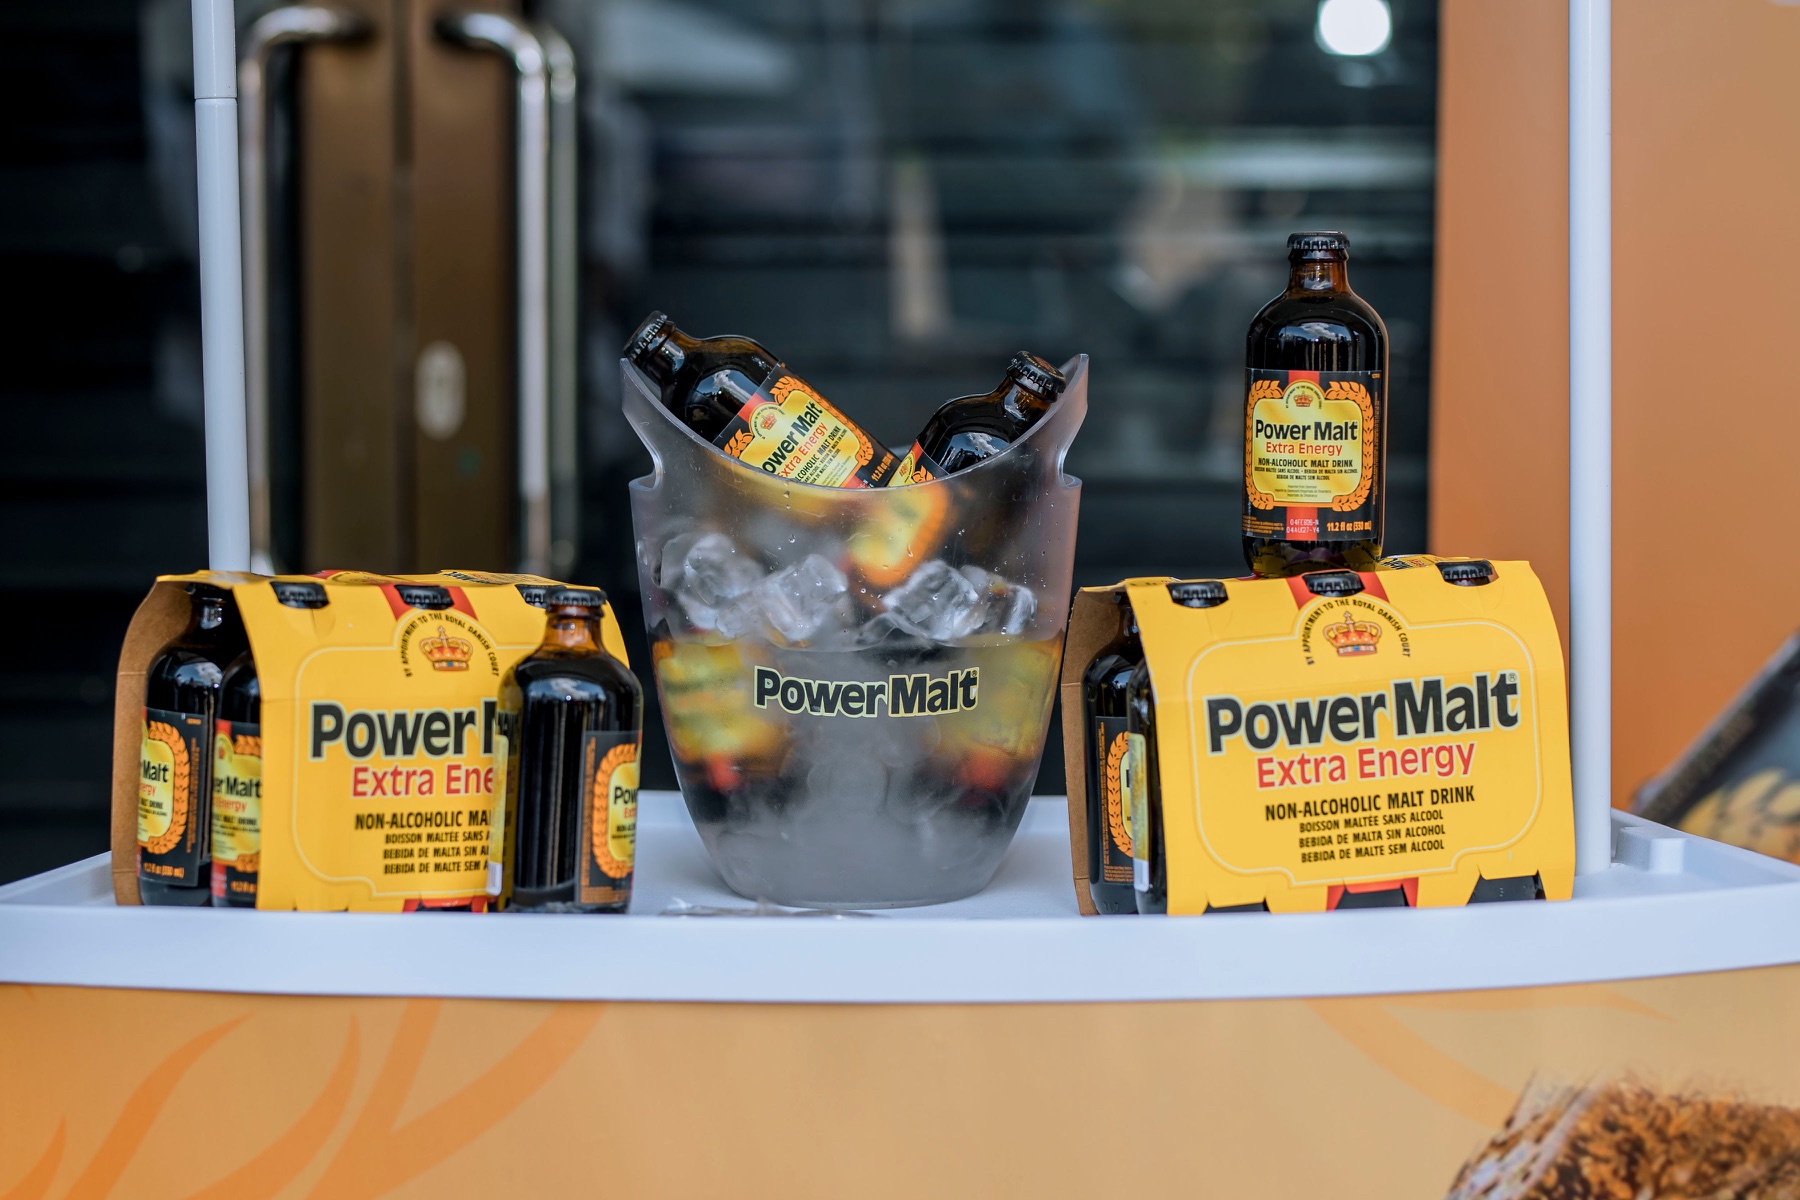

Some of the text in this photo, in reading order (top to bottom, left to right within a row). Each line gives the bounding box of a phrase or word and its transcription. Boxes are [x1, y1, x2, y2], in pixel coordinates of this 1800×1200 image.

[761, 429, 799, 474] ower
[791, 401, 823, 437] Malt
[798, 421, 828, 456] Energy
[1255, 419, 1358, 441] Power Malt
[795, 453, 820, 482] LCOHOLIC
[817, 438, 832, 456] MALT
[1265, 441, 1343, 456] Extra Energy
[1257, 457, 1353, 468] NON-ALCOHOLIC MALT DRINK
[1327, 521, 1340, 532] 11.2
[1323, 602, 1334, 611] TO
[1334, 598, 1350, 607] THE
[1352, 599, 1376, 612] ROYAL
[1377, 608, 1403, 632] DANISH
[1398, 632, 1411, 658] COURT
[417, 614, 428, 624] TO
[428, 612, 443, 621] THE
[445, 613, 466, 629] ROYAL
[467, 625, 492, 651] DANISH
[487, 651, 500, 677] COURT
[755, 667, 887, 717] Power
[310, 701, 478, 759] Power
[1206, 692, 1387, 754] Power
[142, 759, 169, 783] Malt
[1256, 741, 1476, 789] Extra Energy
[226, 775, 262, 799] Malt
[352, 763, 494, 798] Extra Ene
[1265, 785, 1476, 821] NON-ALCOHOLIC MALT DRINK
[354, 810, 463, 830] NON-ALCOHOLIC
[1299, 819, 1340, 833] BOISSON
[1383, 812, 1407, 826] SANS
[1409, 809, 1444, 823] ALCOOL
[385, 832, 423, 845] BOISSON
[462, 831, 484, 842] SANS
[1298, 824, 1446, 848] BEBIDA DE MALTA SIN ALCOHOL
[383, 848, 415, 860] BEBIDA
[418, 847, 429, 858] DE
[433, 846, 461, 858] MALTA
[464, 845, 478, 857] SIN
[1301, 849, 1336, 863] BEBIDA
[1339, 848, 1351, 859] DE
[1355, 845, 1385, 858] MALTE
[1388, 842, 1407, 855] SEM
[384, 863, 416, 874] BEBIDA
[419, 862, 430, 873] DE
[434, 861, 462, 872] MALTE
[464, 860, 481, 871] SEM
